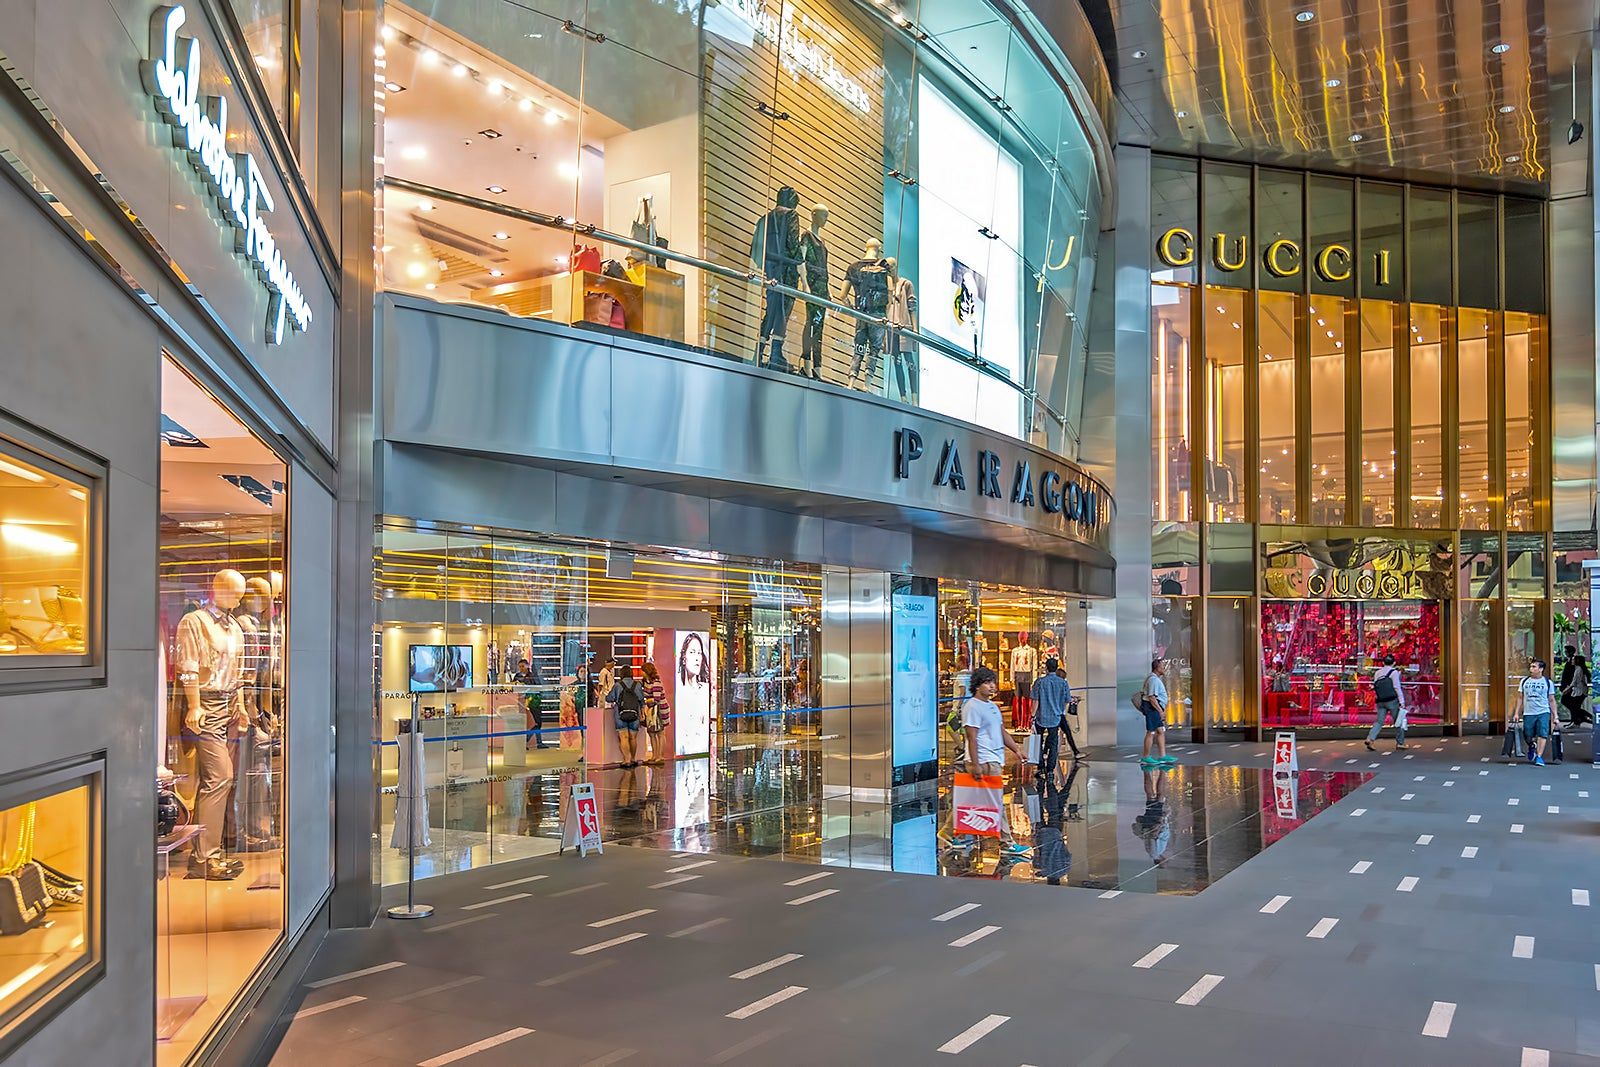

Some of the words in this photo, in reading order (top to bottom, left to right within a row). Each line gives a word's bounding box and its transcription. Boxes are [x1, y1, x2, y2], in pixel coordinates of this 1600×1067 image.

[156, 5, 248, 230] Salvatore
[245, 153, 313, 346] Ferragamo
[1159, 227, 1391, 286] GUCCI
[899, 427, 1097, 526] PARAGON
[1307, 573, 1410, 596] GUCCI
[903, 602, 925, 612] PARAGON
[384, 692, 423, 700] PARAGON
[481, 687, 514, 696] PARAGON
[551, 767, 580, 775] PARAGON
[480, 775, 513, 784] PARAGON
